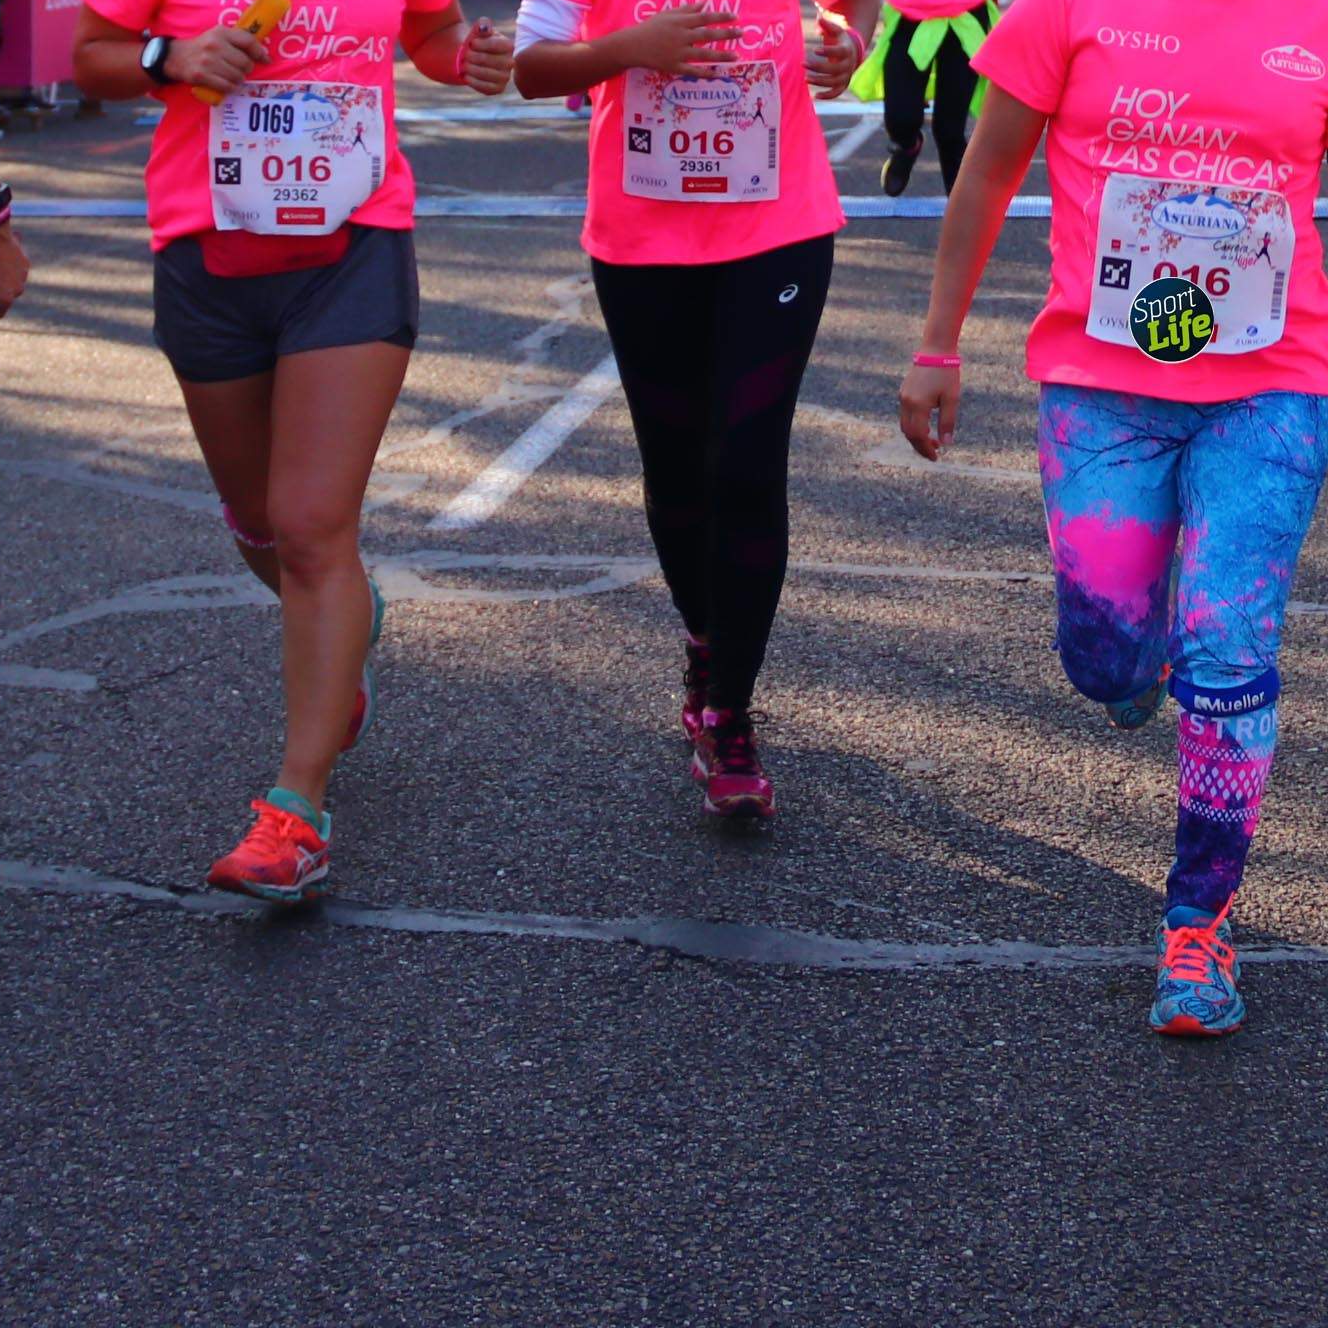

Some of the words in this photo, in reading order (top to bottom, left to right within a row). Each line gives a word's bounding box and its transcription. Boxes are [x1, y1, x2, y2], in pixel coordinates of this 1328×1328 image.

[278, 35, 388, 62] CHICAS
[1097, 26, 1180, 54] OYSHO
[1267, 54, 1322, 76] ASTURIANA
[669, 86, 737, 100] ASTURIANA
[1110, 85, 1191, 120] HOY
[249, 102, 294, 134] 0169
[669, 130, 734, 155] 016
[1106, 118, 1238, 152] GANAN
[262, 155, 331, 182] 016
[680, 160, 720, 172] 29361
[1099, 143, 1161, 173] LAS
[1169, 151, 1294, 187] CHICAS
[273, 189, 318, 201] 29362
[1160, 206, 1239, 231] ASTURIANA
[1134, 286, 1196, 324] Sport
[1100, 314, 1129, 329] OYS
[1148, 309, 1211, 352] Life
[1205, 689, 1265, 712] Mueller
